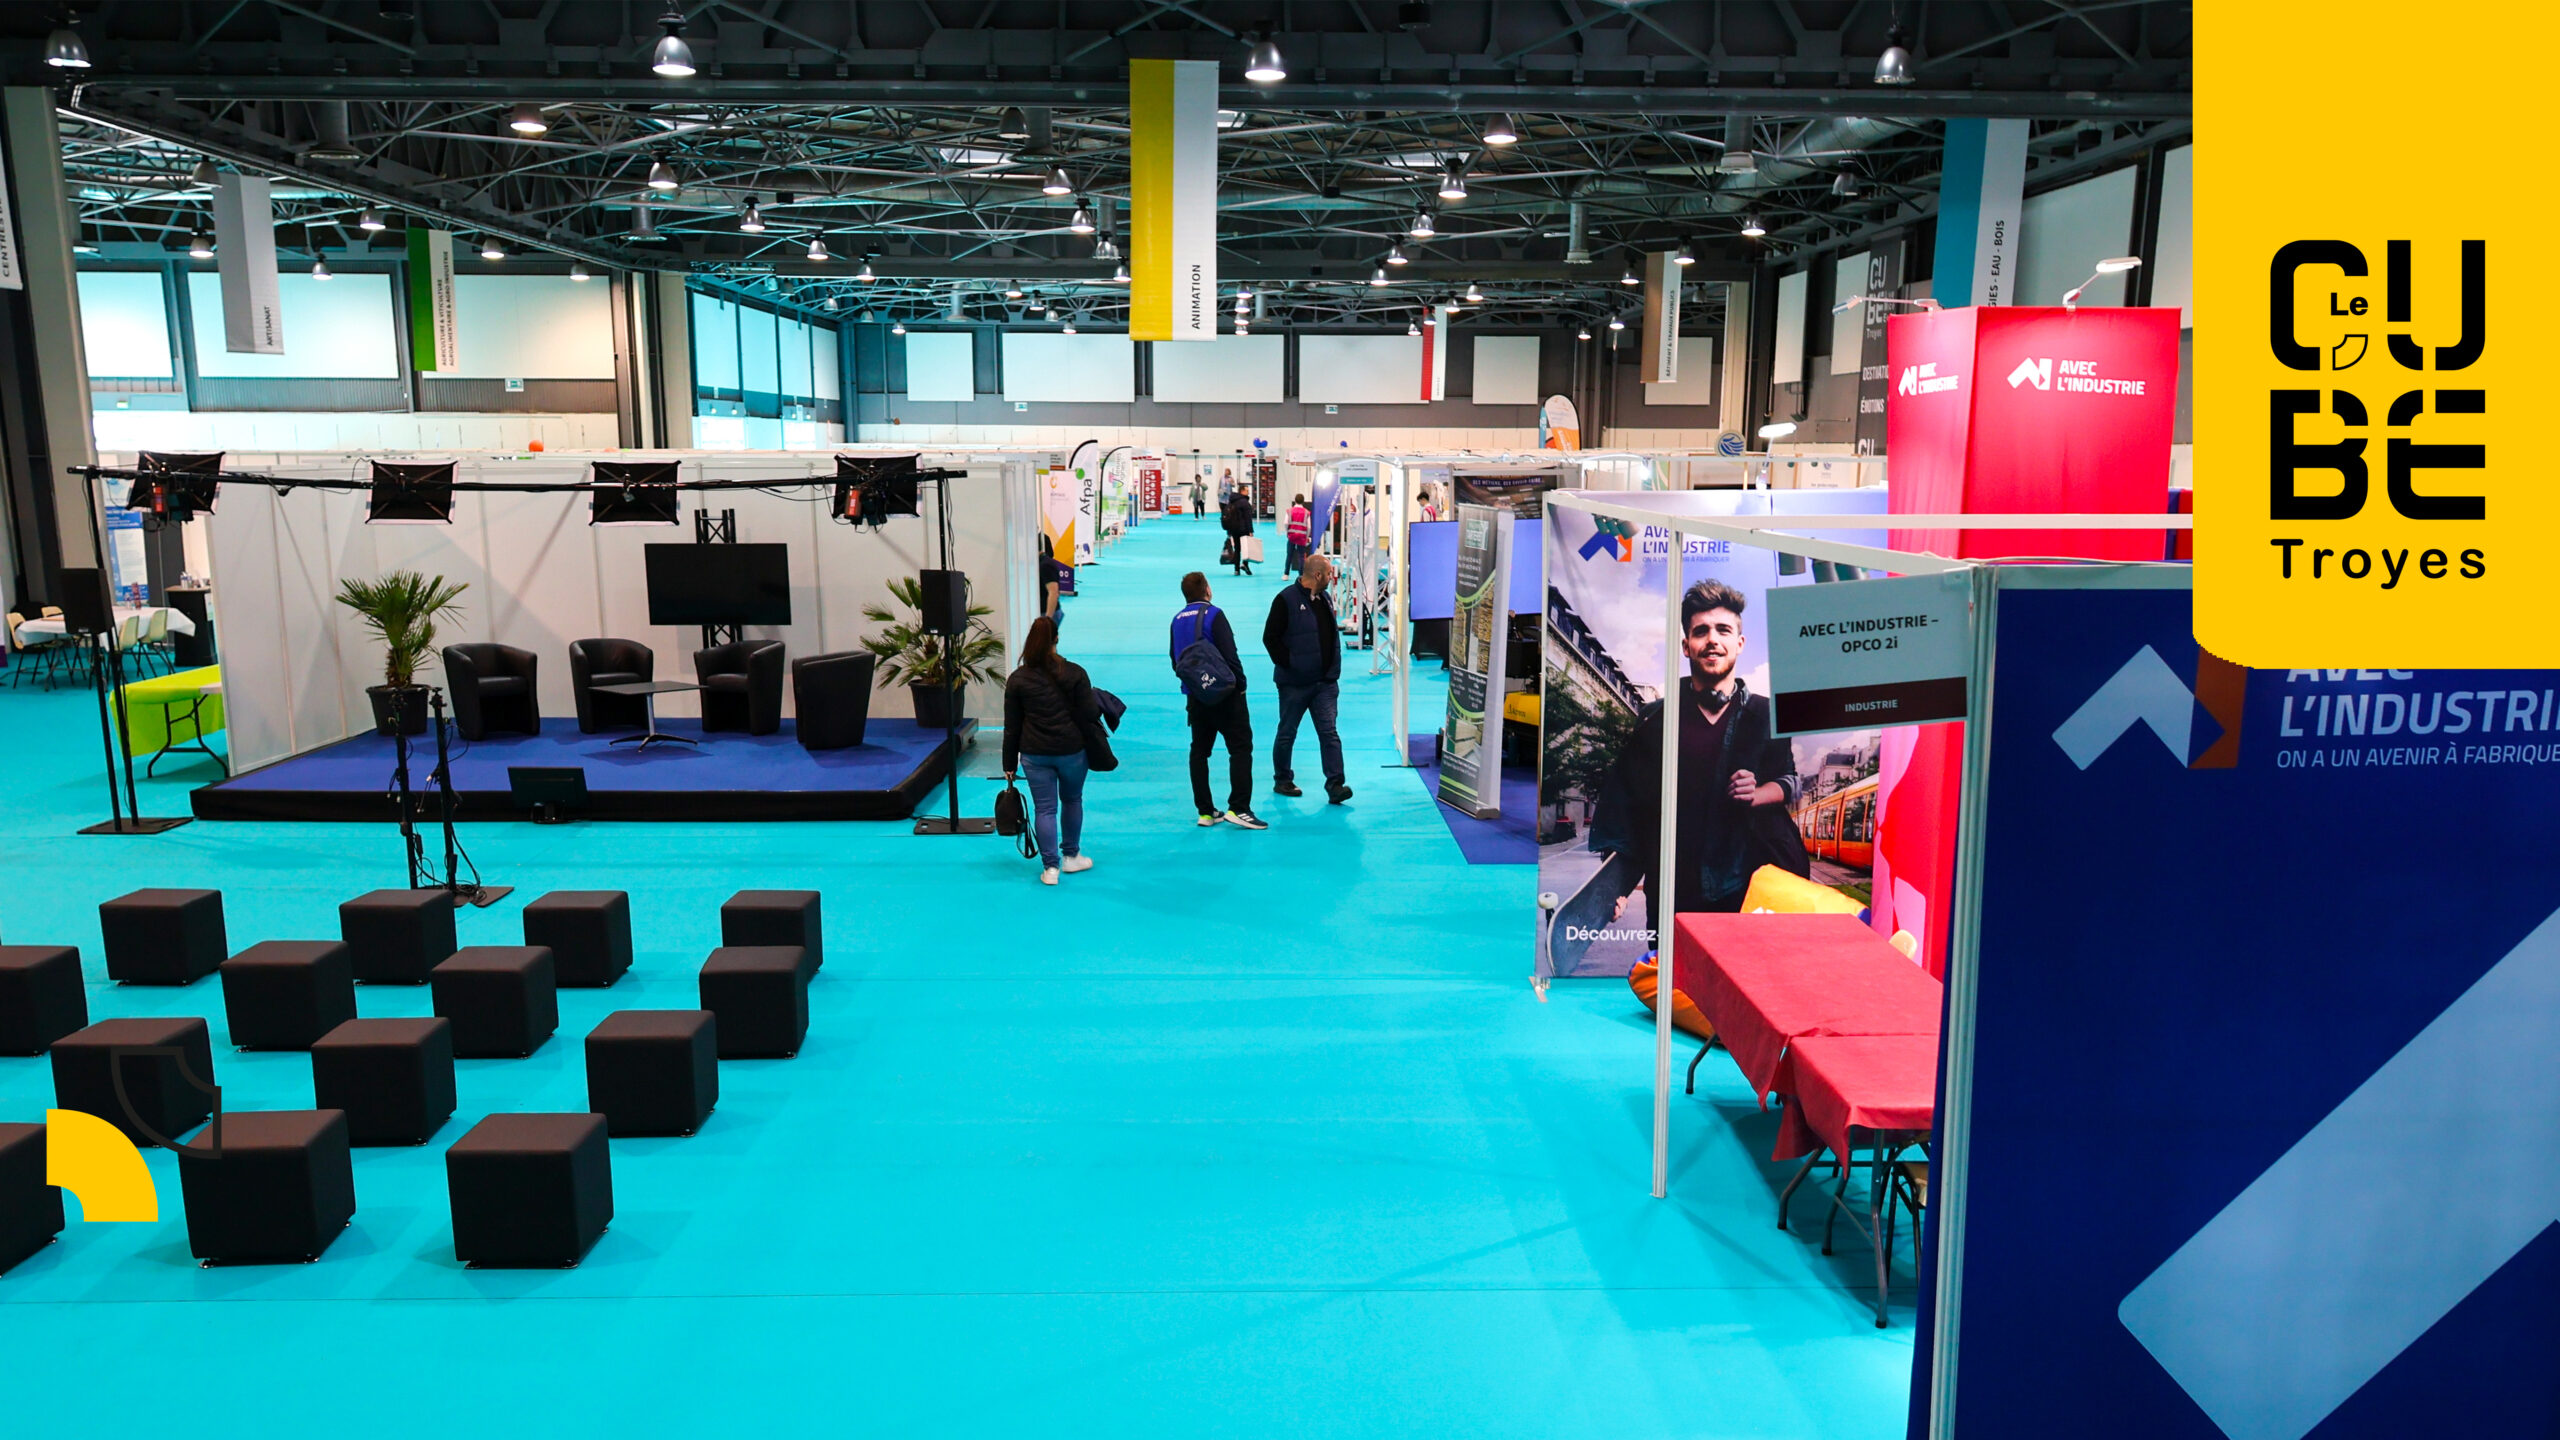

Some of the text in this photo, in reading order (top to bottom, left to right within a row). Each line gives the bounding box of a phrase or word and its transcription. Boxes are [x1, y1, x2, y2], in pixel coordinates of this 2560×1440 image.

[1994, 220, 2005, 246] BOIS
[1991, 255, 2001, 276] EAU
[1191, 264, 1201, 330] ANIMATION
[264, 304, 273, 346] ARTISANAT
[2059, 359, 2098, 376] AVEC
[2057, 376, 2146, 396] L'INDUSTRIE
[1079, 478, 1094, 516] Afpa
[1644, 525, 1669, 538] AVE
[1643, 541, 1730, 554] L'INUSTRIE
[1799, 623, 1835, 638] AVEC
[1839, 615, 1928, 634] L'INDUSTRIE
[1841, 636, 1898, 653] OPCO 2i
[1845, 699, 1898, 712] INDUSTRIE
[2280, 689, 2560, 737] L'INDUSTRI
[2277, 750, 2306, 768] ON
[2311, 750, 2325, 768] A
[2331, 749, 2360, 767] UN
[2365, 747, 2440, 766] AVENIR
[2444, 741, 2457, 764] À
